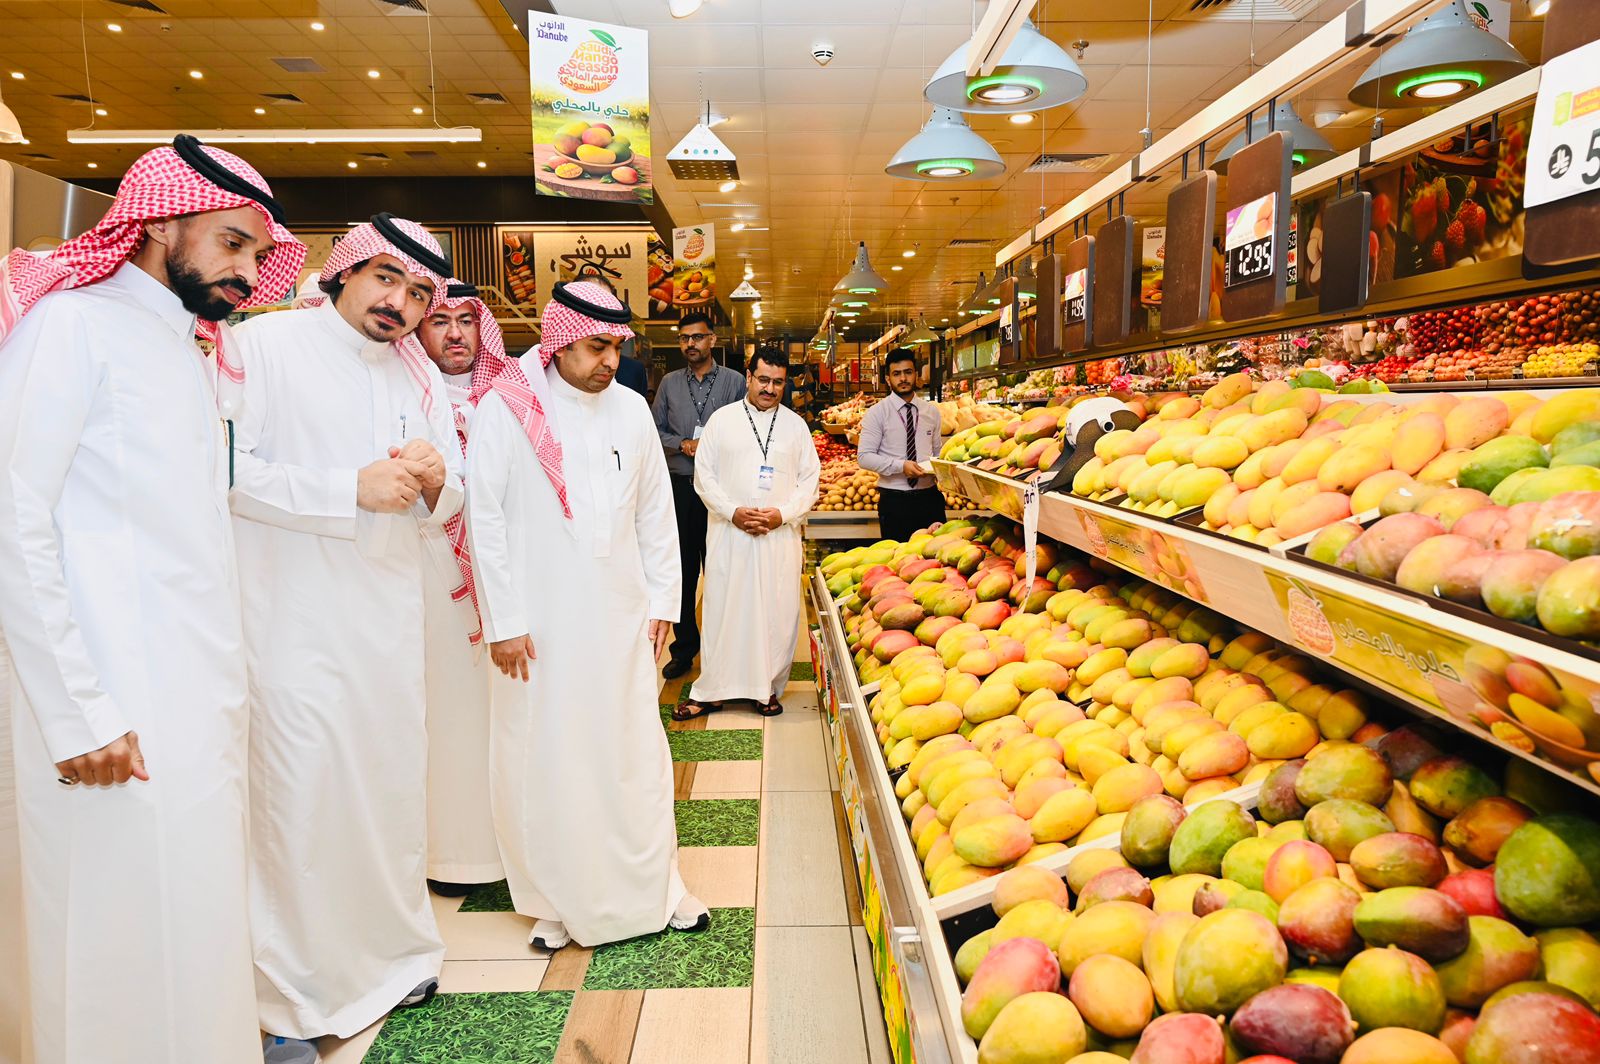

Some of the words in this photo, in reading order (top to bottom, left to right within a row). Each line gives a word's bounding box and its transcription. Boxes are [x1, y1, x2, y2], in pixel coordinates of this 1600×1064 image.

[536, 28, 568, 42] Danube
[571, 50, 618, 66] Mango
[567, 59, 618, 75] Season
[559, 76, 600, 92] السعودي
[591, 73, 617, 85] موسم
[552, 98, 601, 114] بالمحلي
[603, 105, 629, 119] حلي
[1238, 241, 1271, 276] 12.95
[1332, 618, 1413, 669] بالمحلي
